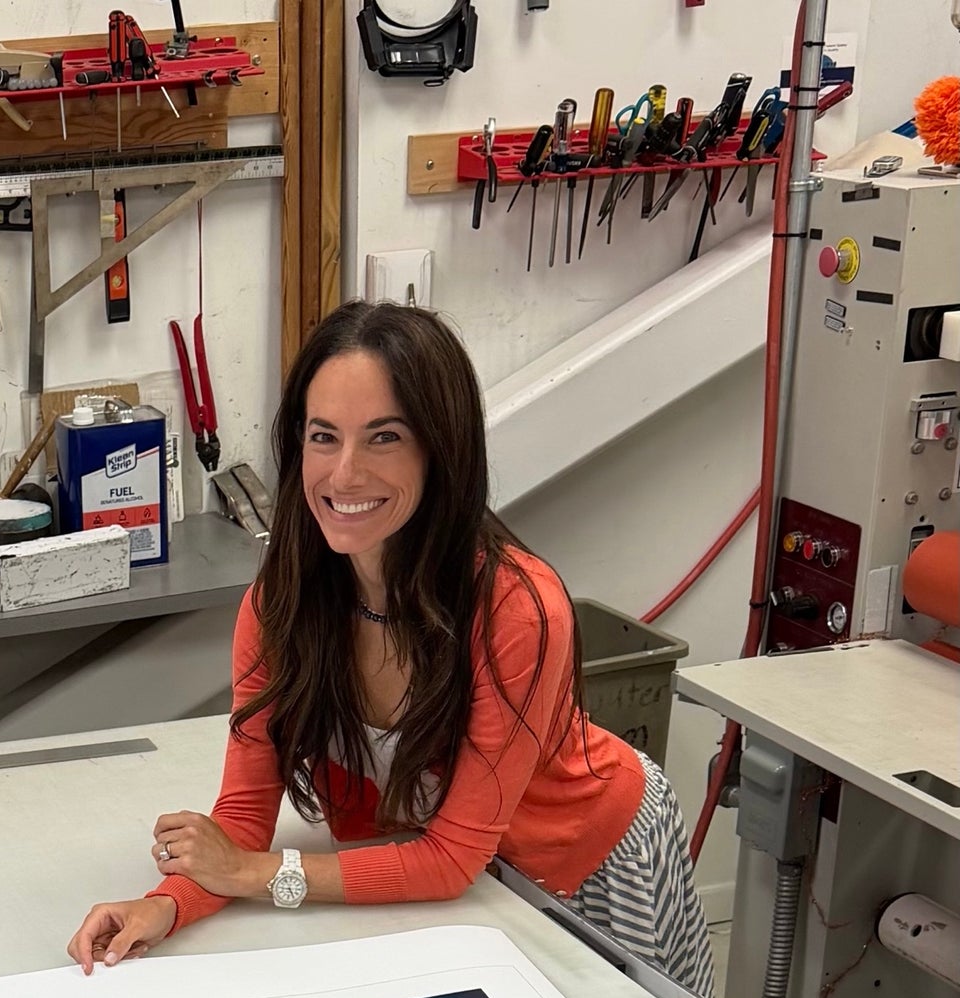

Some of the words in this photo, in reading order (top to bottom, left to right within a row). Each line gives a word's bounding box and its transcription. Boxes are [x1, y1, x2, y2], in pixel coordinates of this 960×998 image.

[108, 450, 134, 466] Kleen
[111, 459, 132, 473] Strip
[109, 486, 135, 498] FUEL
